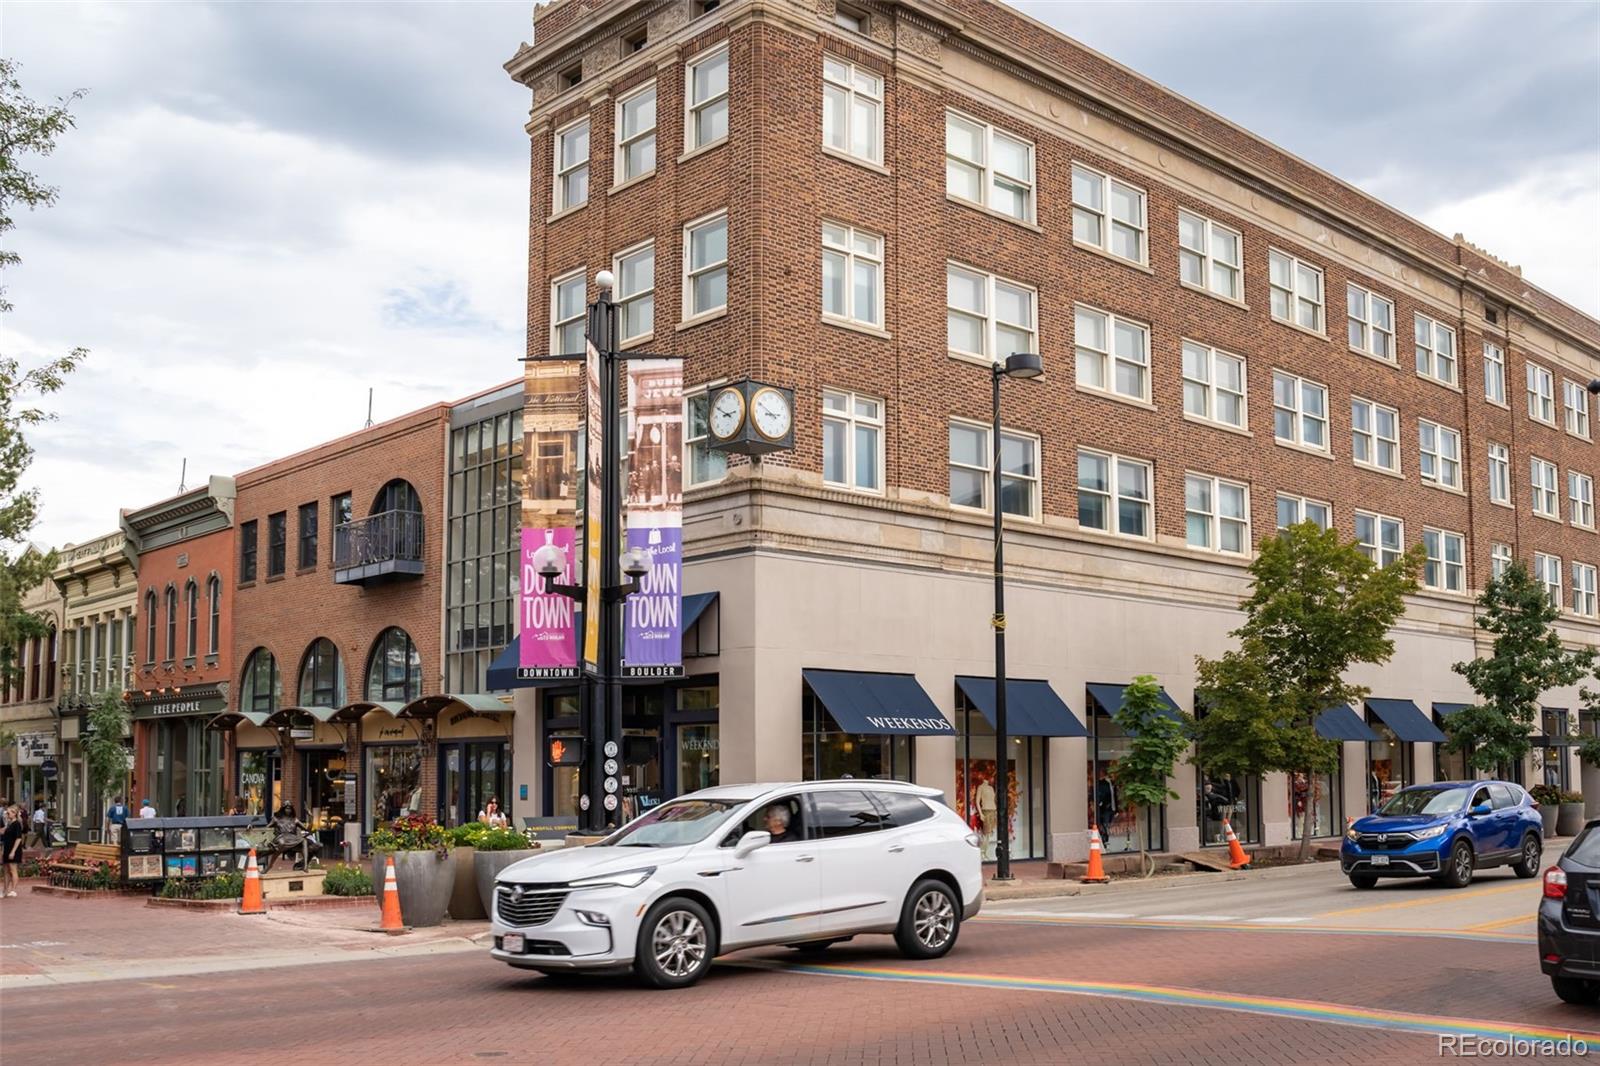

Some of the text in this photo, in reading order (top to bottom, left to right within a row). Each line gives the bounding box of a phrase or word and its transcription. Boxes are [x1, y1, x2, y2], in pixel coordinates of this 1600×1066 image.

[657, 541, 676, 555] Local
[631, 563, 677, 594] OWN
[523, 596, 570, 629] TOWN
[629, 595, 677, 628] TOWN
[523, 667, 574, 677] DOWNTOWN
[630, 666, 675, 676] BOULDER
[153, 701, 200, 715] FREE PEOPLE
[866, 716, 951, 730] WEEKENDS
